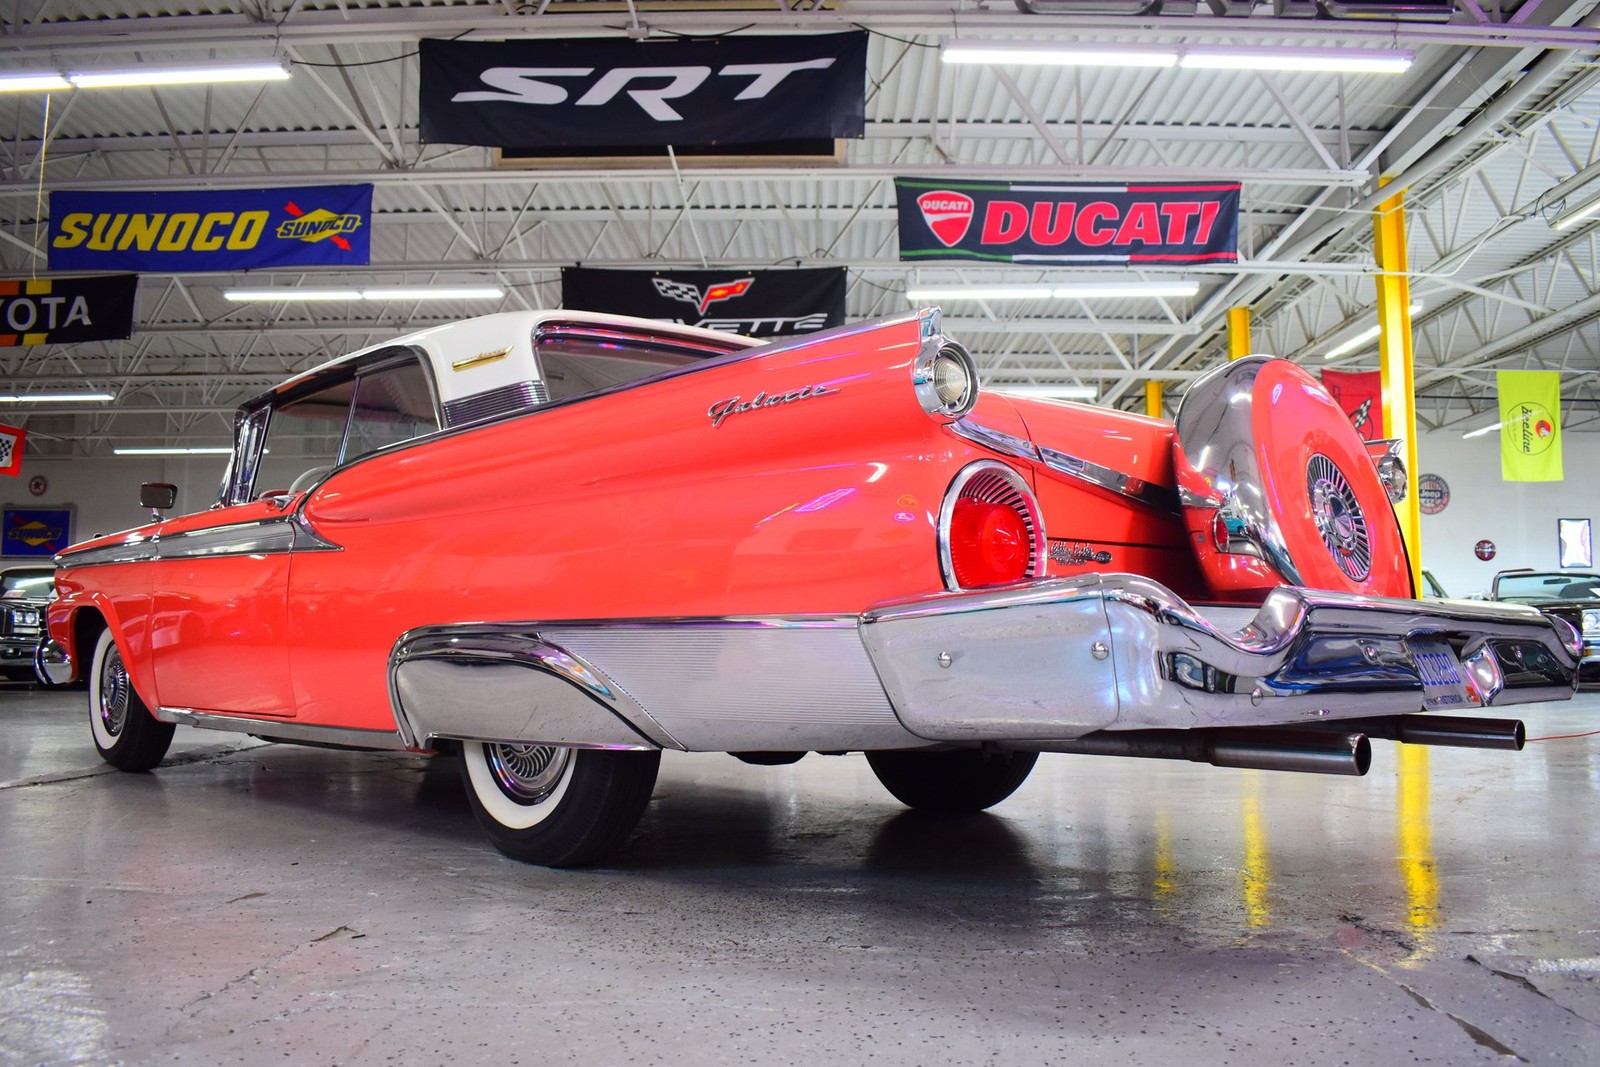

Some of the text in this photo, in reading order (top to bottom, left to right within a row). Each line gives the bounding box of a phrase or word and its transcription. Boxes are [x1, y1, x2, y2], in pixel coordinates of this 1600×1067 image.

[451, 57, 837, 121] SRT
[923, 200, 969, 211] DUCATI
[980, 201, 1220, 245] DUCATI
[52, 210, 270, 251] SUNOCO
[280, 214, 359, 238] SUNOCO
[0, 296, 92, 331] OTA
[707, 384, 841, 428] Galaxie
[1420, 489, 1440, 499] Jeep
